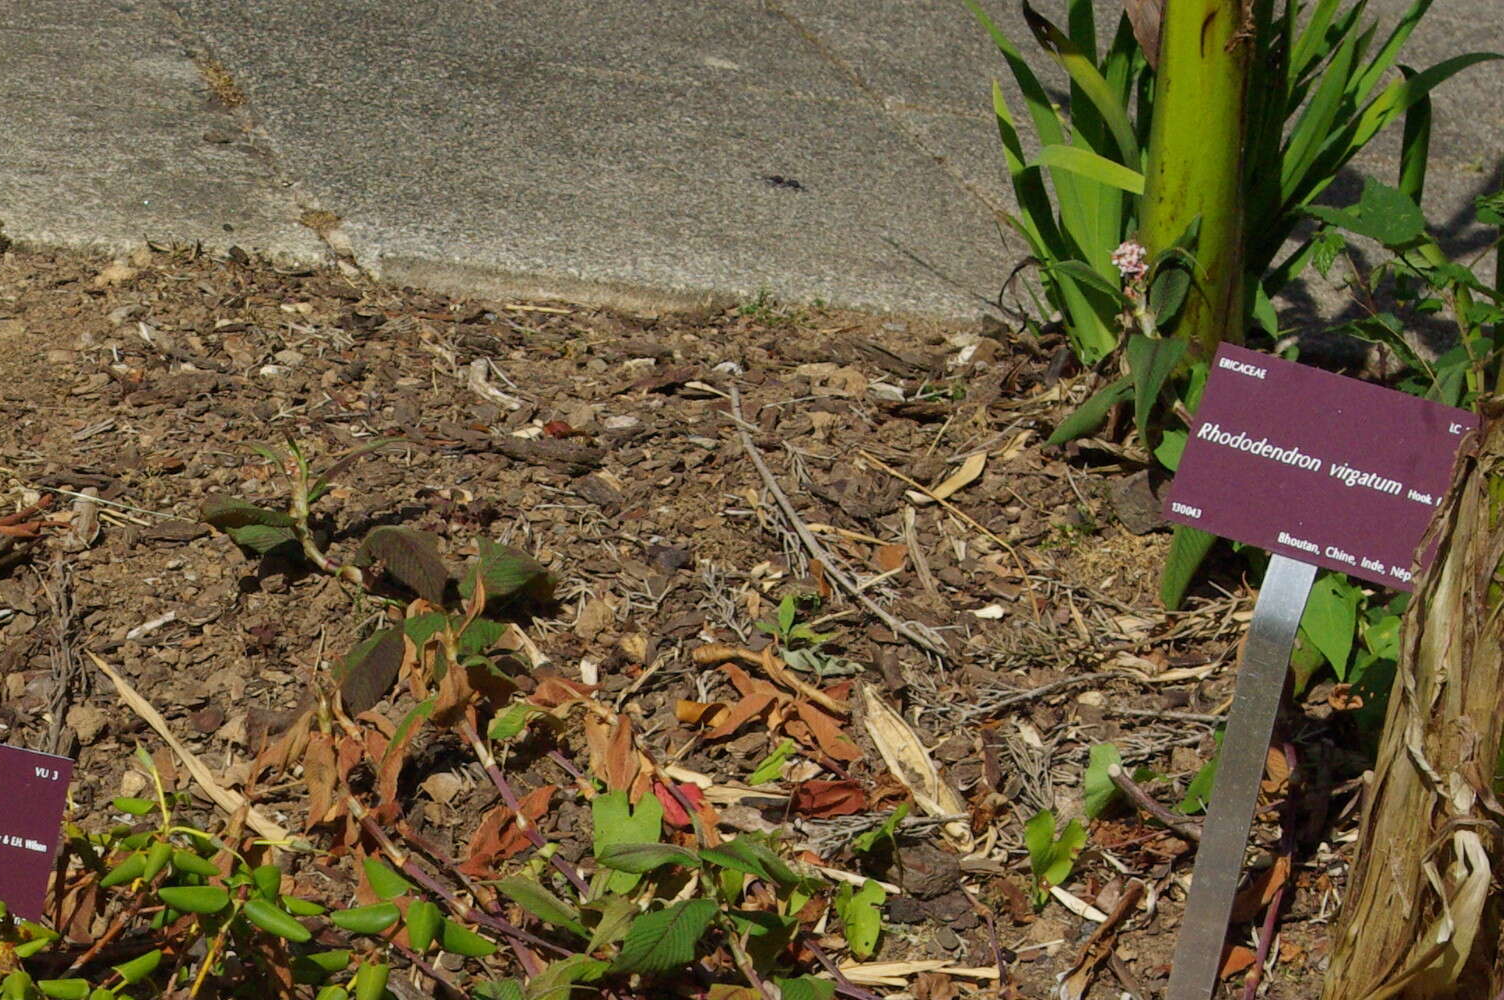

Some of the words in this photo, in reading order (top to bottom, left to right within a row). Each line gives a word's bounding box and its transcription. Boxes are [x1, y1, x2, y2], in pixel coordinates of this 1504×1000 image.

[1218, 357, 1267, 380] ERICACEAE
[1448, 422, 1462, 435] LC
[1196, 422, 1322, 472] Rhododendron
[1329, 462, 1403, 495] virgatum
[1171, 502, 1202, 519] 130043
[1277, 531, 1321, 555] Bhoutan,
[1325, 546, 1357, 566] Chine,
[1360, 556, 1386, 575] Inde,
[1390, 565, 1412, 582] Nép
[35, 766, 50, 778] VU
[51, 770, 59, 781] 3
